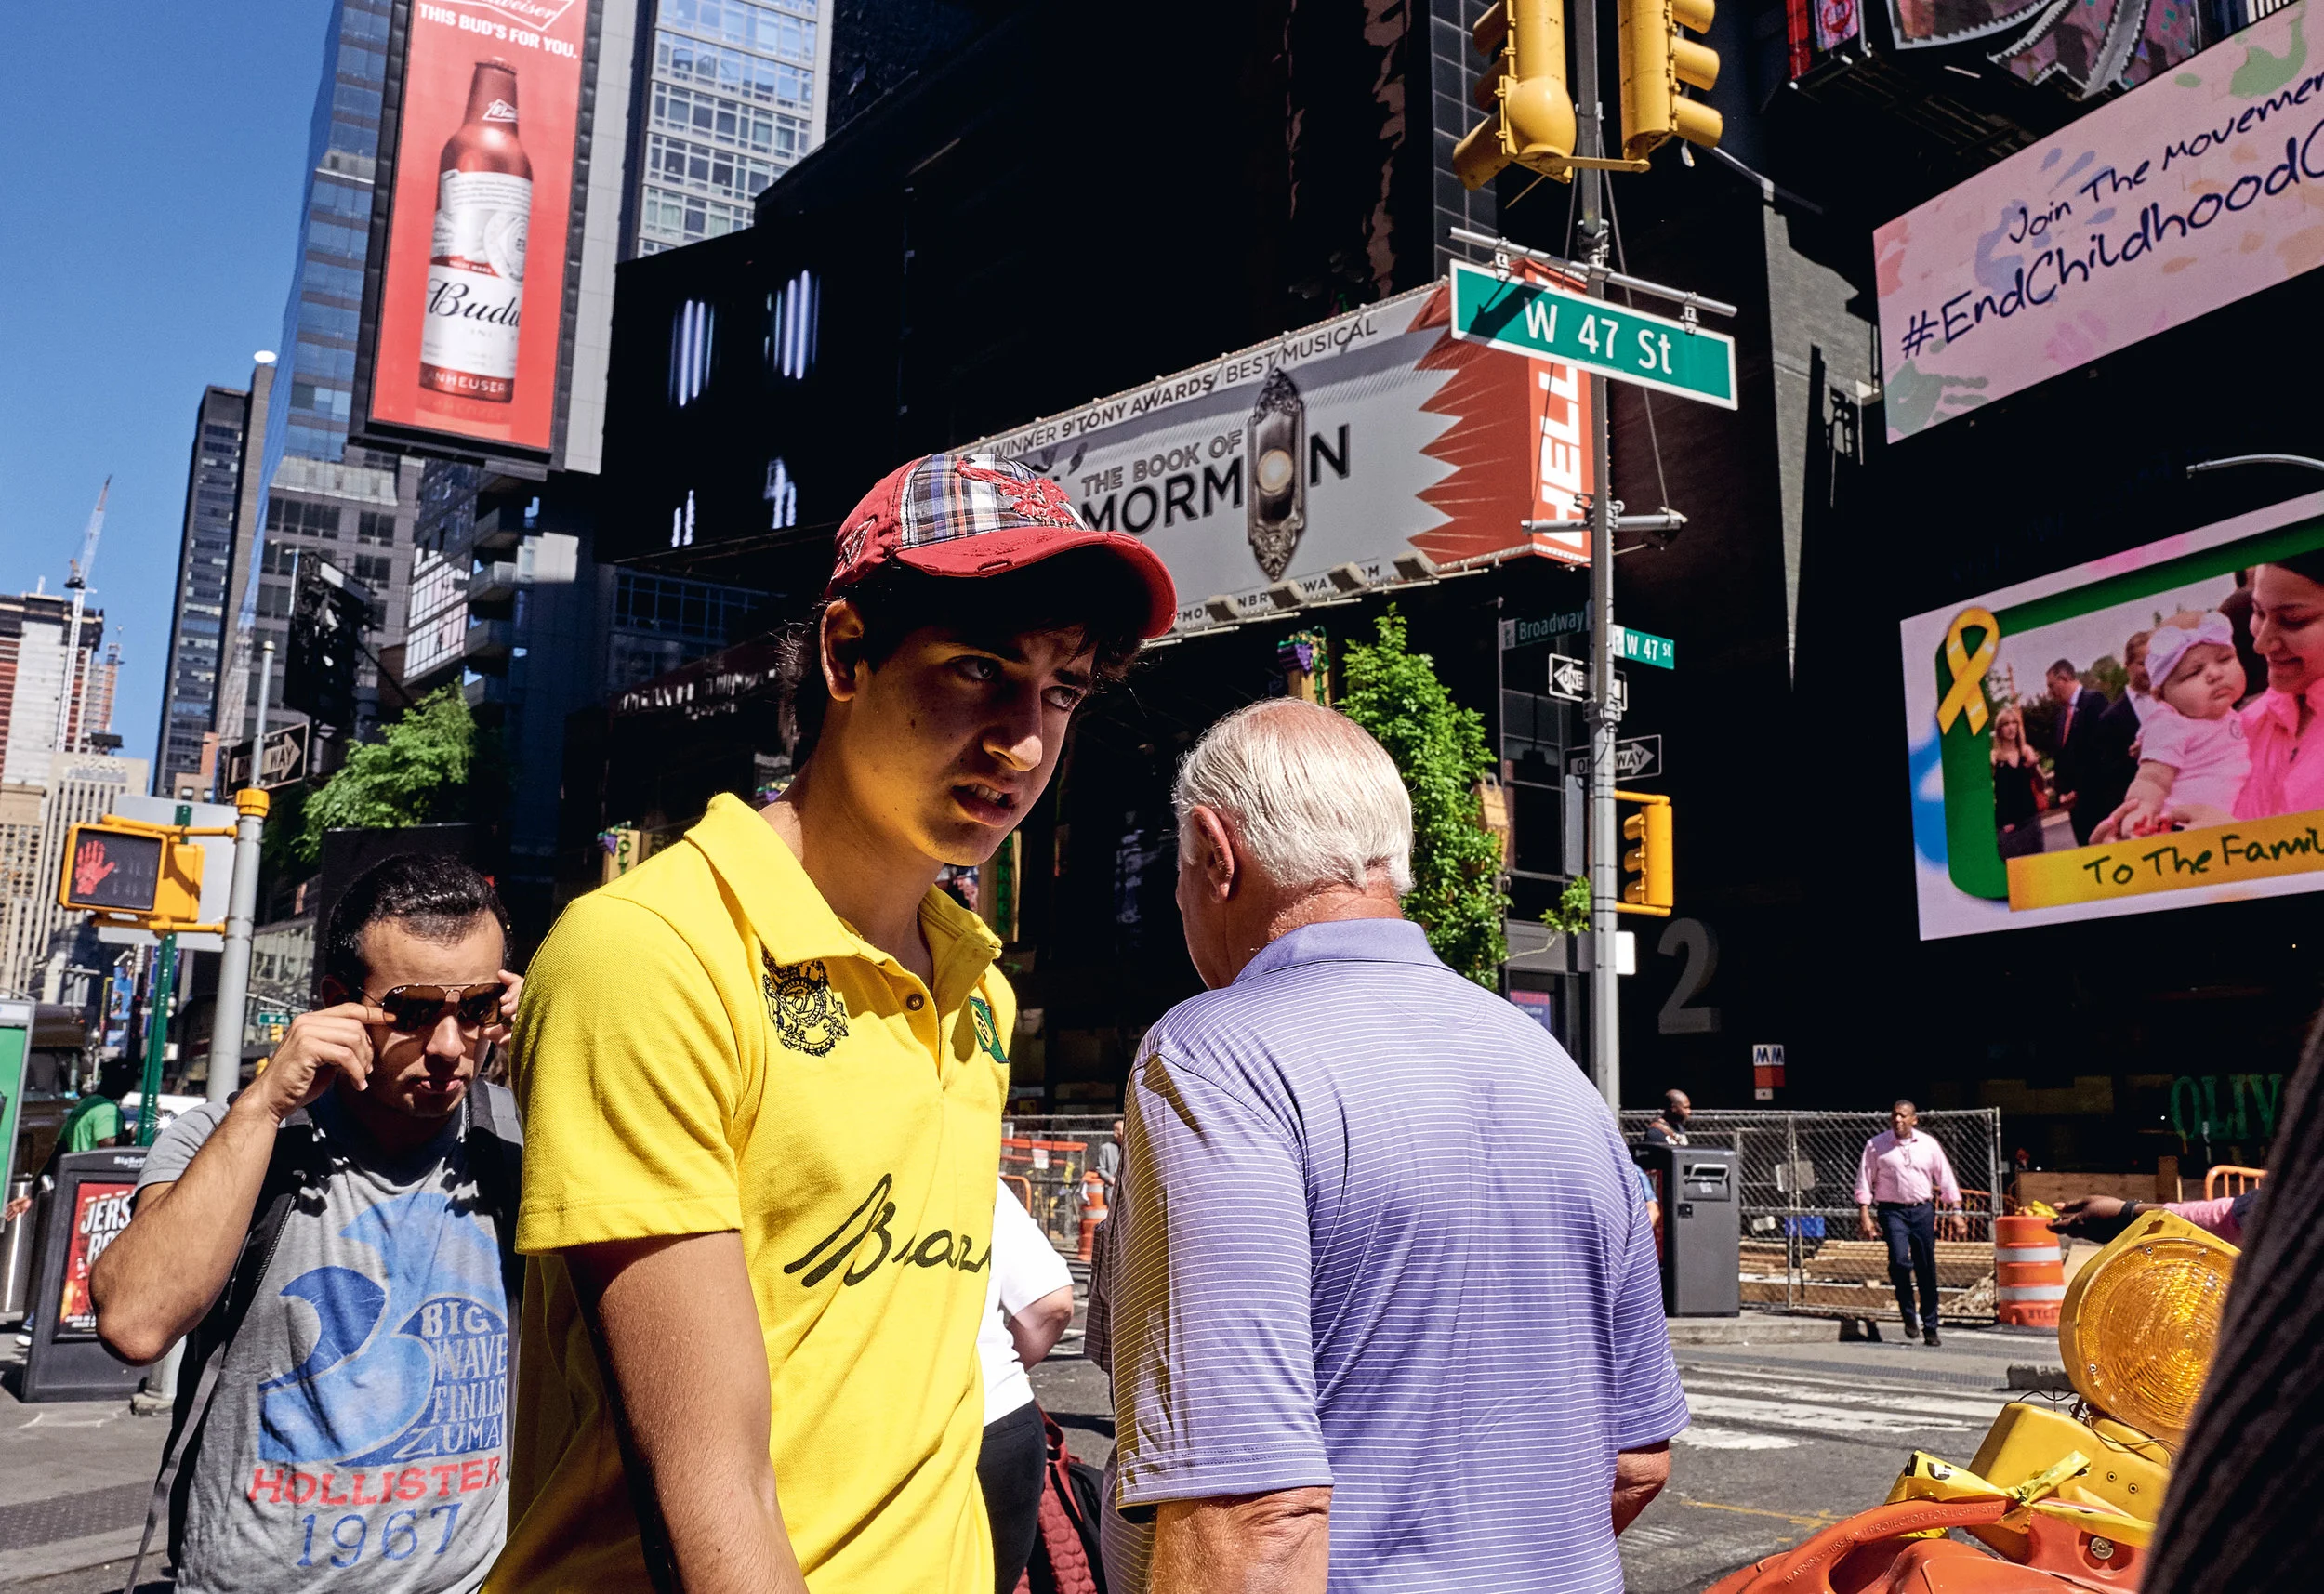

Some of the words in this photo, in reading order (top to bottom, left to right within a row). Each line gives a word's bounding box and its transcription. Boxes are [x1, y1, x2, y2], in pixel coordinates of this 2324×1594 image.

[419, 3, 456, 27] THIS
[459, 14, 507, 40] BUD'S
[509, 27, 540, 49] FOR
[542, 36, 578, 59] YOU.
[2008, 201, 2071, 244] Join
[2080, 160, 2151, 203] The
[1524, 296, 1558, 344] W
[1578, 314, 1619, 359] 47
[1638, 329, 1673, 375] St
[990, 427, 1056, 457] WINNER
[1076, 402, 1128, 432] TONY
[1130, 375, 1214, 415] AWARDS
[1226, 352, 1277, 384] BEST
[1282, 318, 1378, 364] MUSICAL
[1080, 466, 1124, 498] THE
[1132, 441, 1202, 484] BOOK
[1208, 428, 1243, 459] OF
[1538, 362, 1582, 548] HELL
[1519, 611, 1585, 640] Broadway
[1626, 633, 1639, 656] W
[1644, 638, 1659, 661] 47
[271, 744, 295, 768] WAY
[1616, 749, 1645, 768] WAY
[2083, 855, 2133, 885] To
[2143, 845, 2212, 875] The
[1657, 917, 1718, 1034] 2
[784, 1173, 992, 1288] Braz
[420, 1301, 492, 1337] BIG
[432, 1333, 508, 1381] WAVE
[430, 1377, 505, 1425] FINALS
[392, 1416, 501, 1459] ZUMA
[248, 1456, 500, 1507] HOLLISTER
[297, 1502, 464, 1569] 1967
